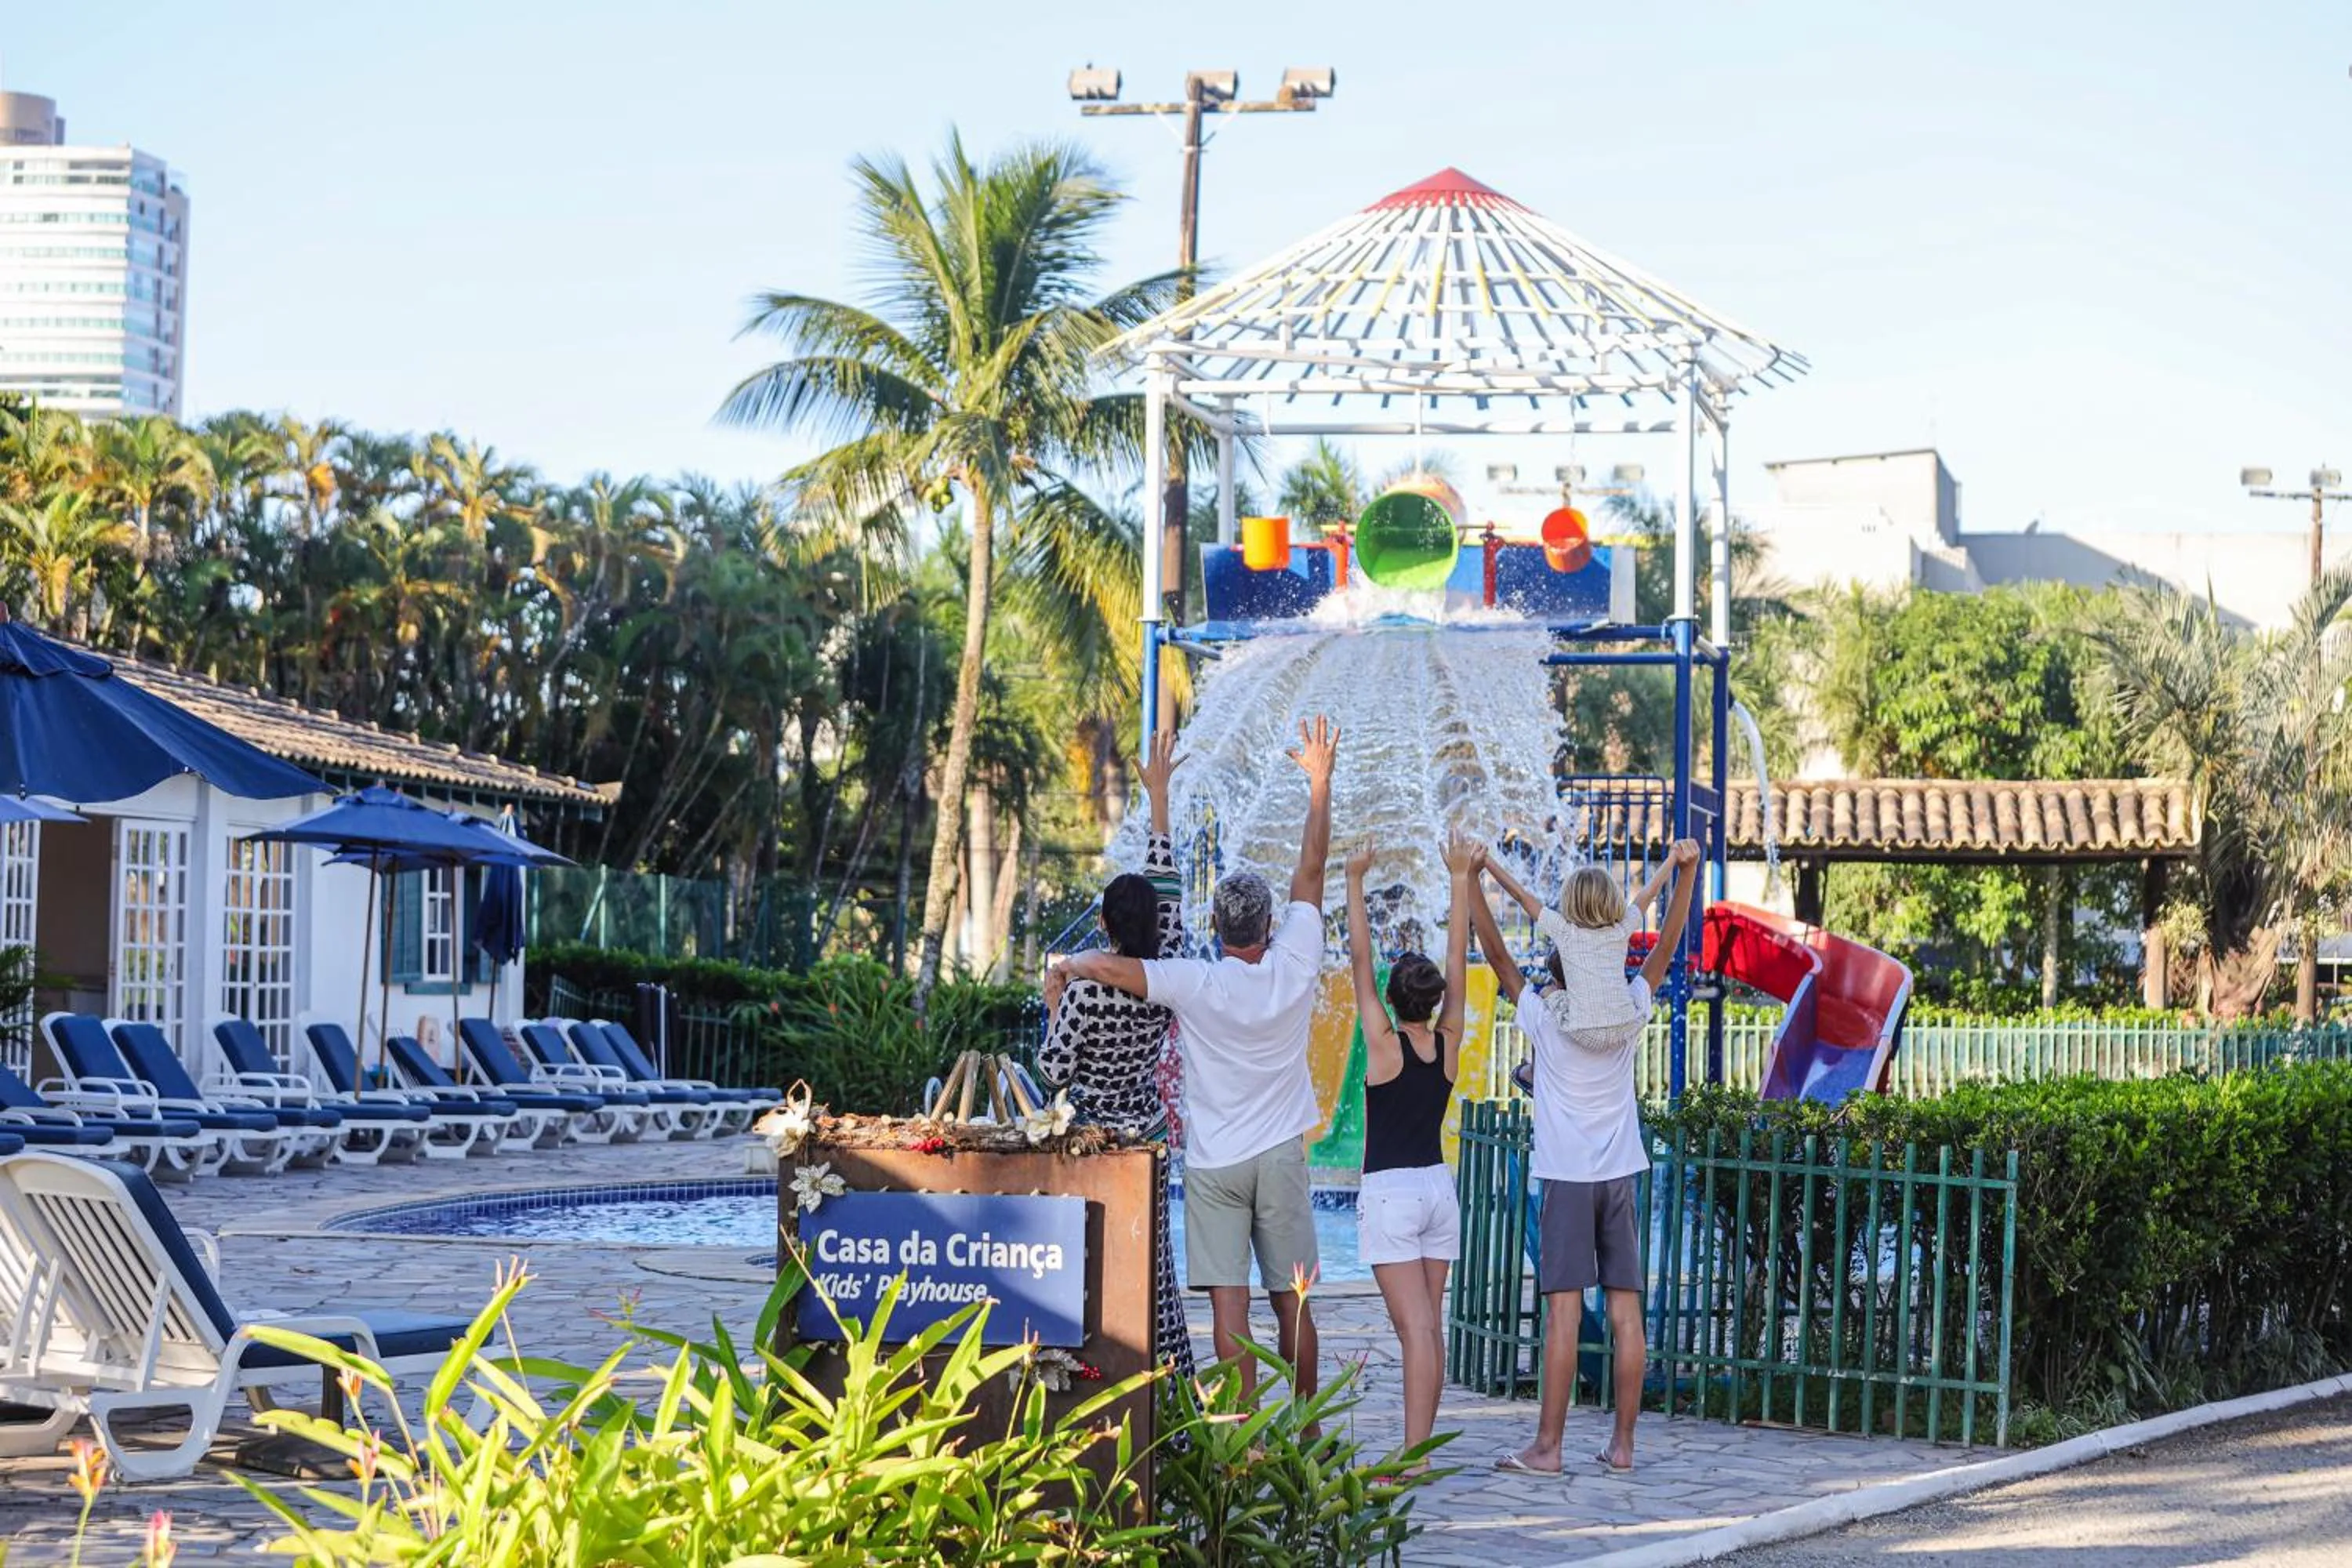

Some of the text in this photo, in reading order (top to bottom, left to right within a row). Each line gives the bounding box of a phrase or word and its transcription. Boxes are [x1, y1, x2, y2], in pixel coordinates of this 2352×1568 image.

[818, 1229, 1063, 1279] Casa da Criança
[875, 1274, 988, 1308] Payhouse
